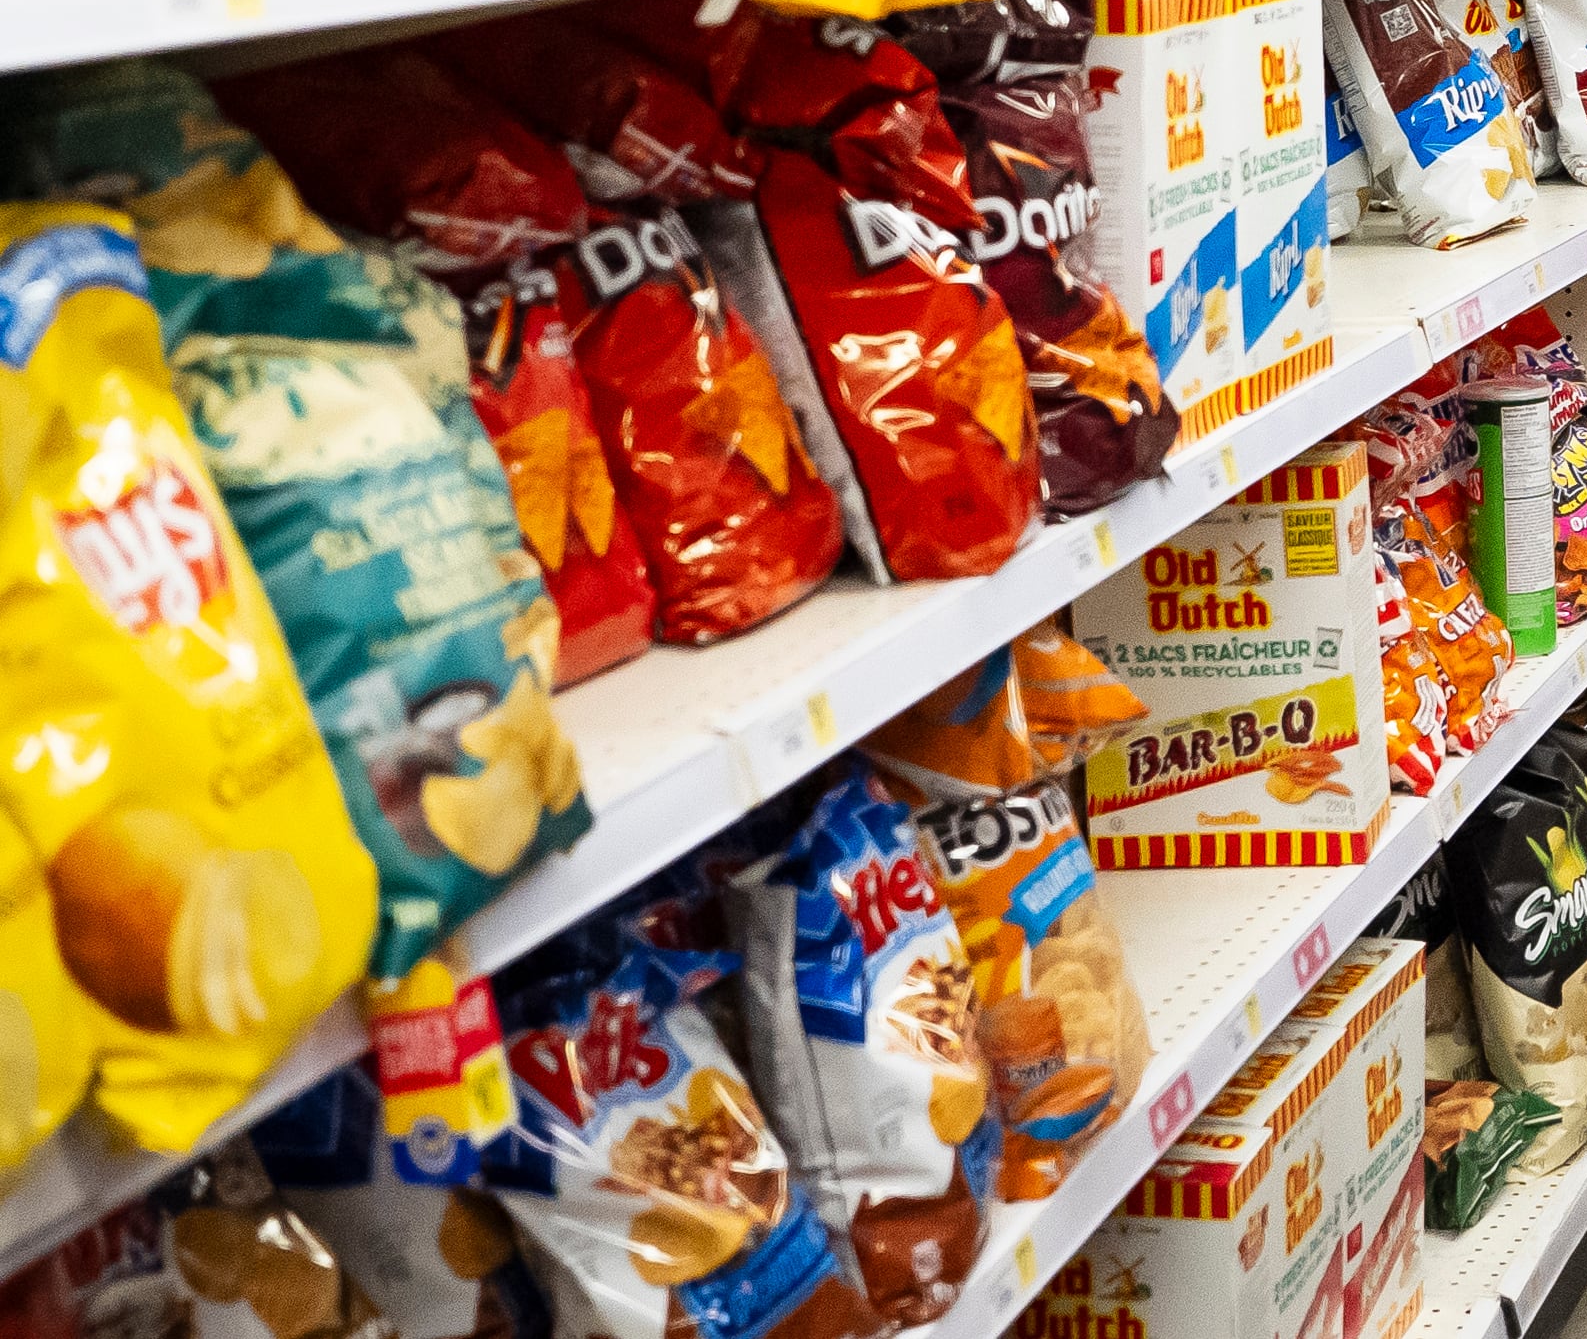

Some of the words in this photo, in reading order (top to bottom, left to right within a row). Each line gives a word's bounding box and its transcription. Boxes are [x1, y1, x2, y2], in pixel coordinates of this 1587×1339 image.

[1287, 512, 1333, 527] SAVEUR
[1287, 528, 1334, 547] CLASSIQUE
[1143, 545, 1219, 589] Old
[1150, 590, 1270, 632] Dutch
[1115, 643, 1130, 663] 2
[1134, 643, 1187, 663] SACS
[1192, 635, 1312, 662] FRAÎCHEUR
[1128, 664, 1157, 679] 100
[1161, 664, 1178, 679] %
[1180, 662, 1303, 679] RECYCLABLES
[1127, 697, 1318, 787] BAR-B-Q
